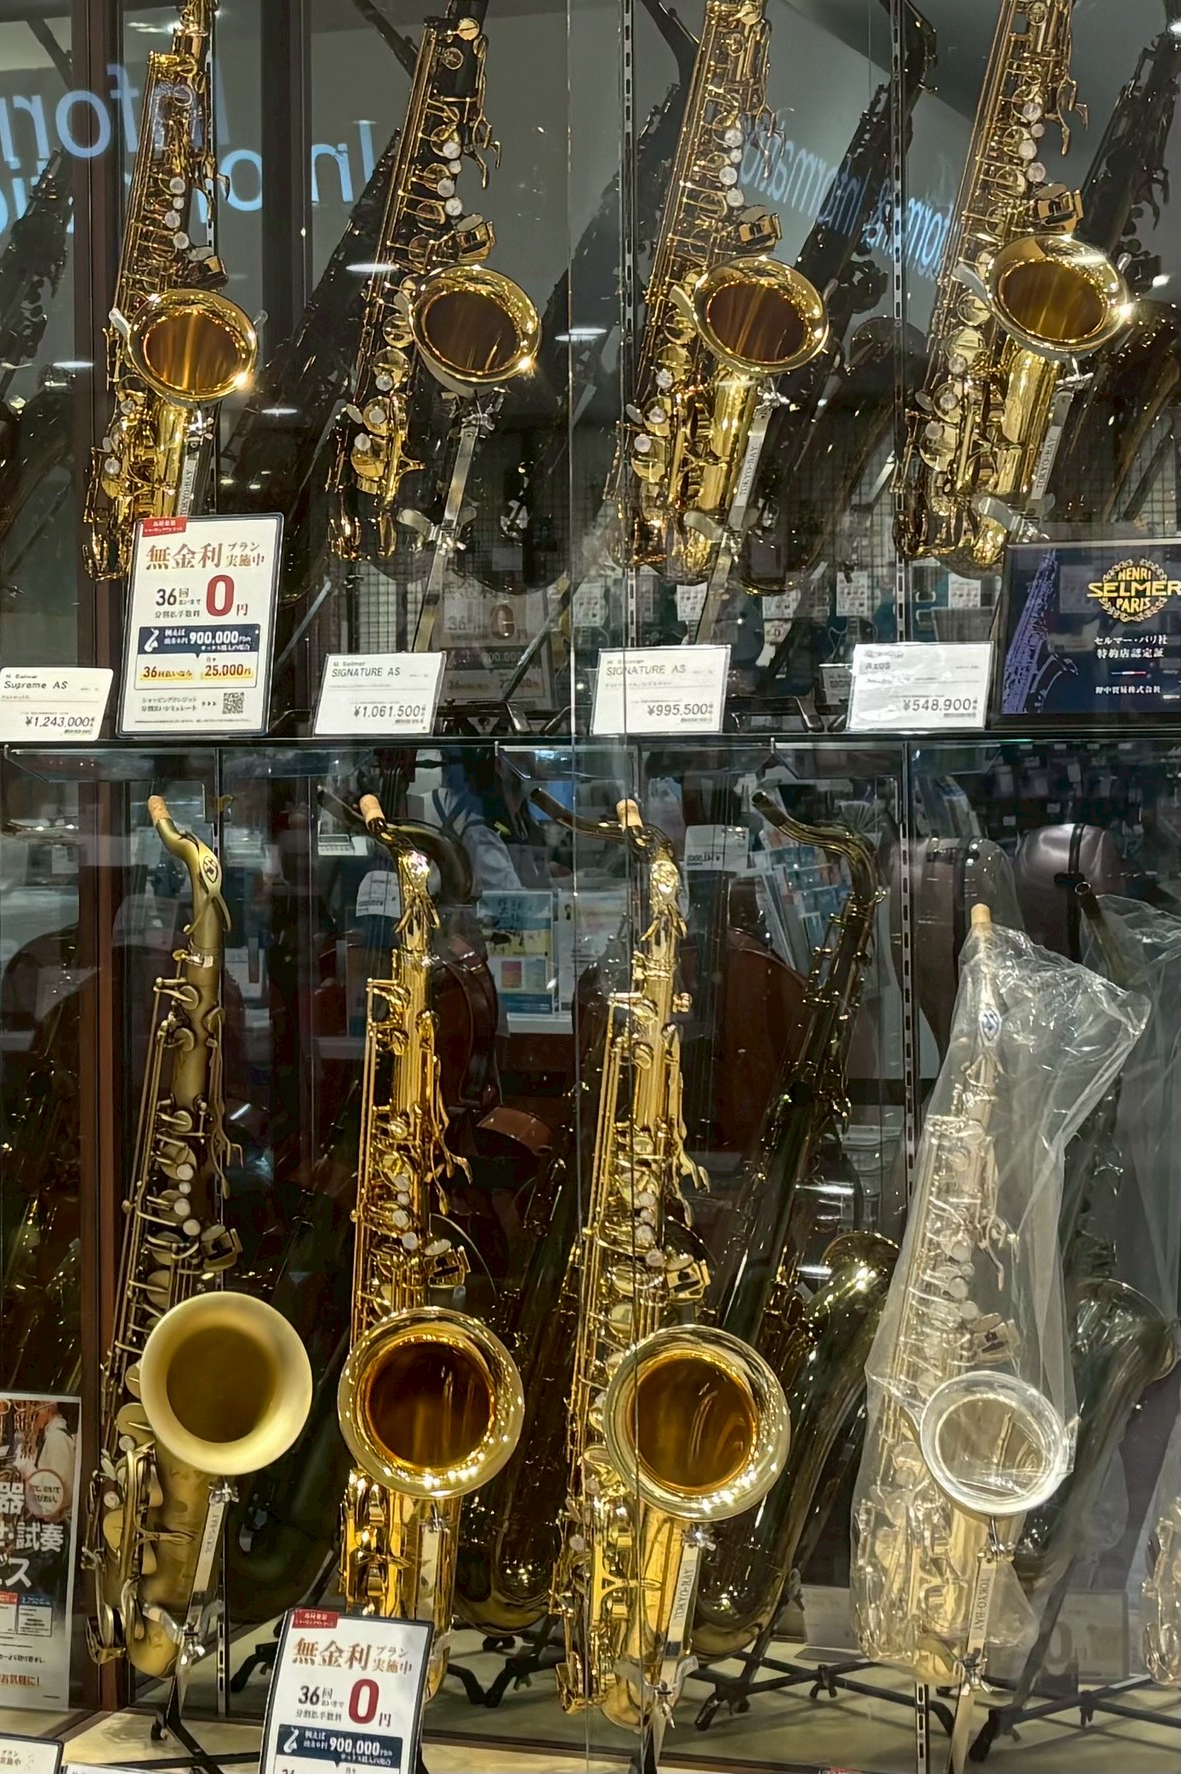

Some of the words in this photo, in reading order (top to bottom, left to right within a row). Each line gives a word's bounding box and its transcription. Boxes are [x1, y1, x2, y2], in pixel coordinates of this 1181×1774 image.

[739, 446, 758, 496] TOKYO-BAY
[228, 542, 260, 551] プラン
[145, 543, 223, 570] 無金利
[226, 553, 265, 568] 実施中
[1117, 567, 1152, 581] HENRI
[1087, 581, 1181, 597] SELMER
[1116, 598, 1151, 613] PARIS
[1094, 635, 1168, 646] セルマー・パリ社
[1096, 648, 1165, 660] 特約店認定証
[331, 667, 383, 678] SIGNATURE
[387, 667, 401, 676] AS
[605, 664, 666, 676] SIGNATURE
[671, 664, 687, 674] AS
[3, 680, 47, 690] Supreme
[52, 680, 69, 690] AS
[354, 705, 421, 718] ¥1,061,500
[647, 703, 708, 717] ¥995,500
[25, 716, 90, 728] ¥1,243,000
[673, 1568, 694, 1620] TOKYO-BAY
[974, 1576, 991, 1631] TOKYO-BAY
[292, 1637, 373, 1671] 無金利
[376, 1645, 410, 1657] プラン
[373, 1657, 413, 1675] 実施中
